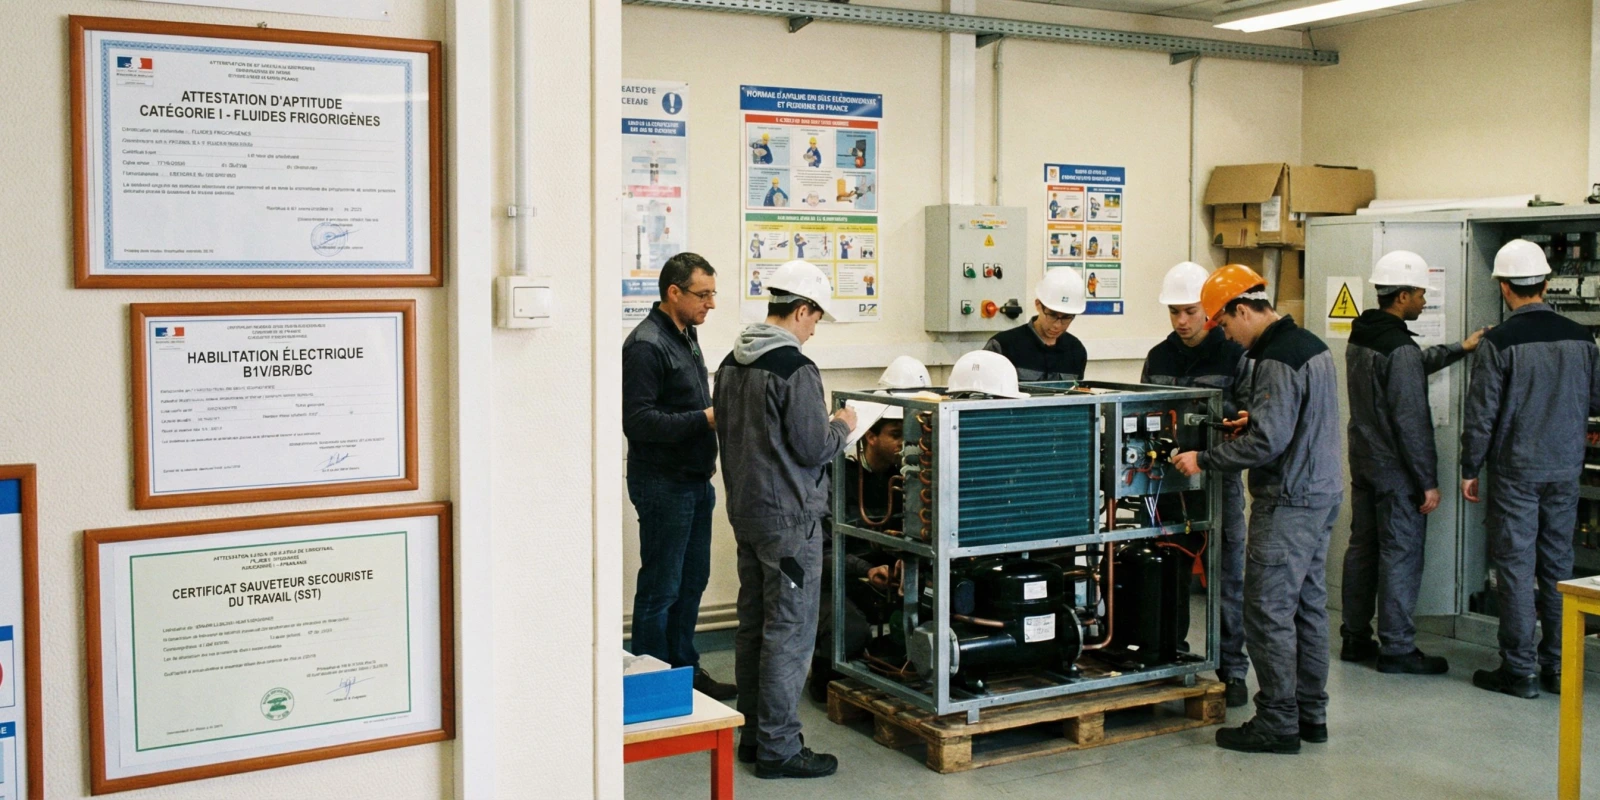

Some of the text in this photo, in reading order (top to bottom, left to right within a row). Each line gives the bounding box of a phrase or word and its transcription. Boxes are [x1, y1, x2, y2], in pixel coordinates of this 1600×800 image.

[181, 90, 342, 110] ATTESTATION D'APTITUDE
[139, 103, 215, 120] CATÉGORIE
[219, 108, 223, 120] I
[234, 109, 287, 123] FLUIDES
[290, 111, 381, 127] FRIGORIGÈNES
[187, 346, 364, 364] HABILITATION ÉLECTRIQUE
[243, 363, 313, 378] B1V/BR/BC
[172, 569, 374, 600] CERTIFICAT SAUVETEUR SECOURISTE
[228, 588, 321, 608] DU TRAVAIL (SST)
